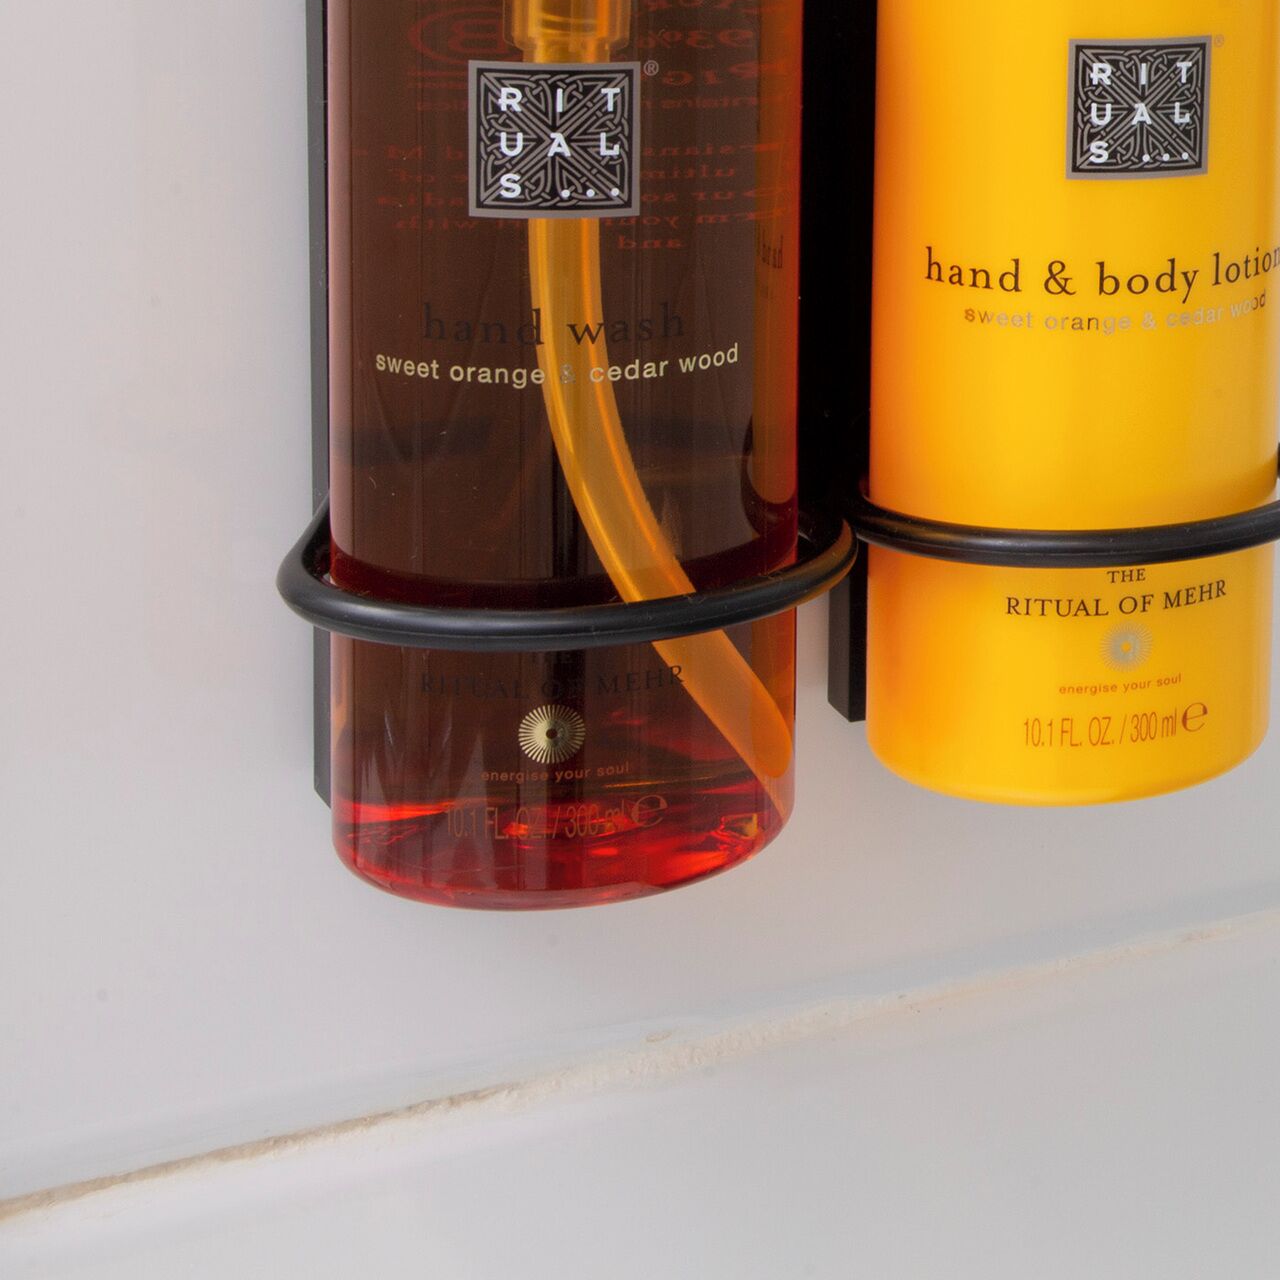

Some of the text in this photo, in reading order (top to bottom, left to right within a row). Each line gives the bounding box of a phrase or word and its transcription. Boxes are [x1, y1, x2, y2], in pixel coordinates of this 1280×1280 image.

[924, 245, 1280, 304] hand & body lotion
[422, 302, 684, 346] hand wash
[964, 289, 1266, 335] sweet orange & cedar wood
[375, 342, 739, 389] sweet orange & cedar wood
[1107, 569, 1146, 583] THE
[1006, 580, 1227, 617] RITUAL OF MEHR
[421, 672, 529, 699] RITUAL
[597, 665, 685, 695] MEHR
[1059, 673, 1182, 696] energise your soul
[1024, 718, 1053, 747] 10.1
[1060, 718, 1082, 746] FL.
[1088, 717, 1114, 746] OZ.
[1119, 714, 1127, 744] /
[1131, 712, 1157, 743] 300
[1161, 708, 1177, 737] ml
[481, 762, 631, 785] energise your soul
[446, 807, 478, 839] 10.1
